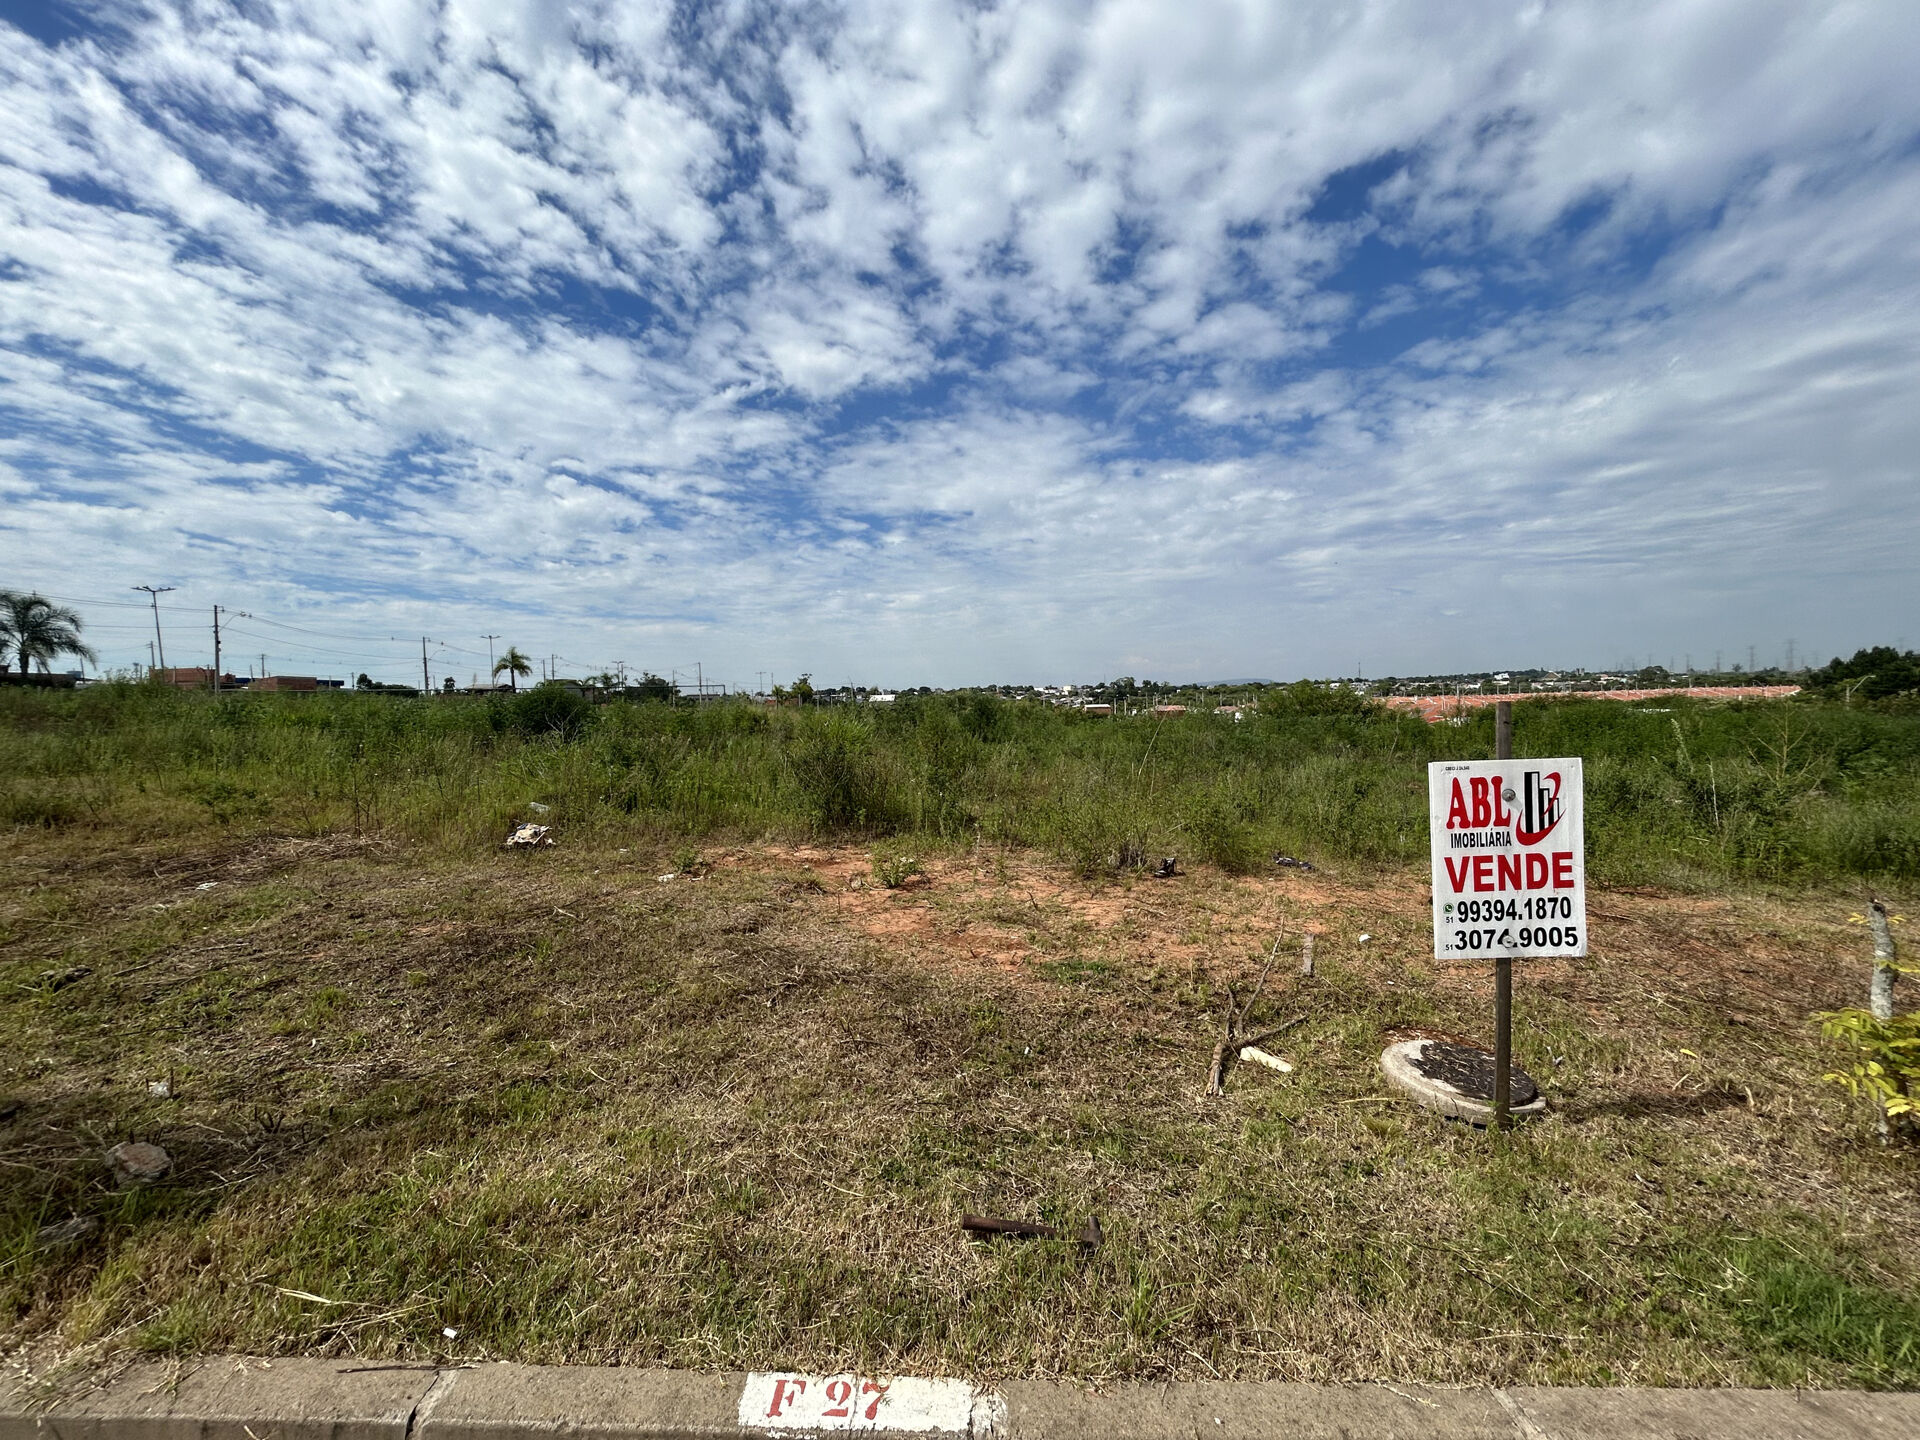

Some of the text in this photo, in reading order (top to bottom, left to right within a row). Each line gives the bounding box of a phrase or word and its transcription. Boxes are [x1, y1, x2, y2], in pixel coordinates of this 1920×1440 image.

[1446, 775, 1511, 829] ABL
[1450, 828, 1512, 849] IMOBILIÁRIA
[1444, 851, 1575, 893] VENDE
[1445, 896, 1572, 924] 51 99394.1870
[1445, 943, 1454, 951] 51
[766, 1379, 889, 1420] F 27
